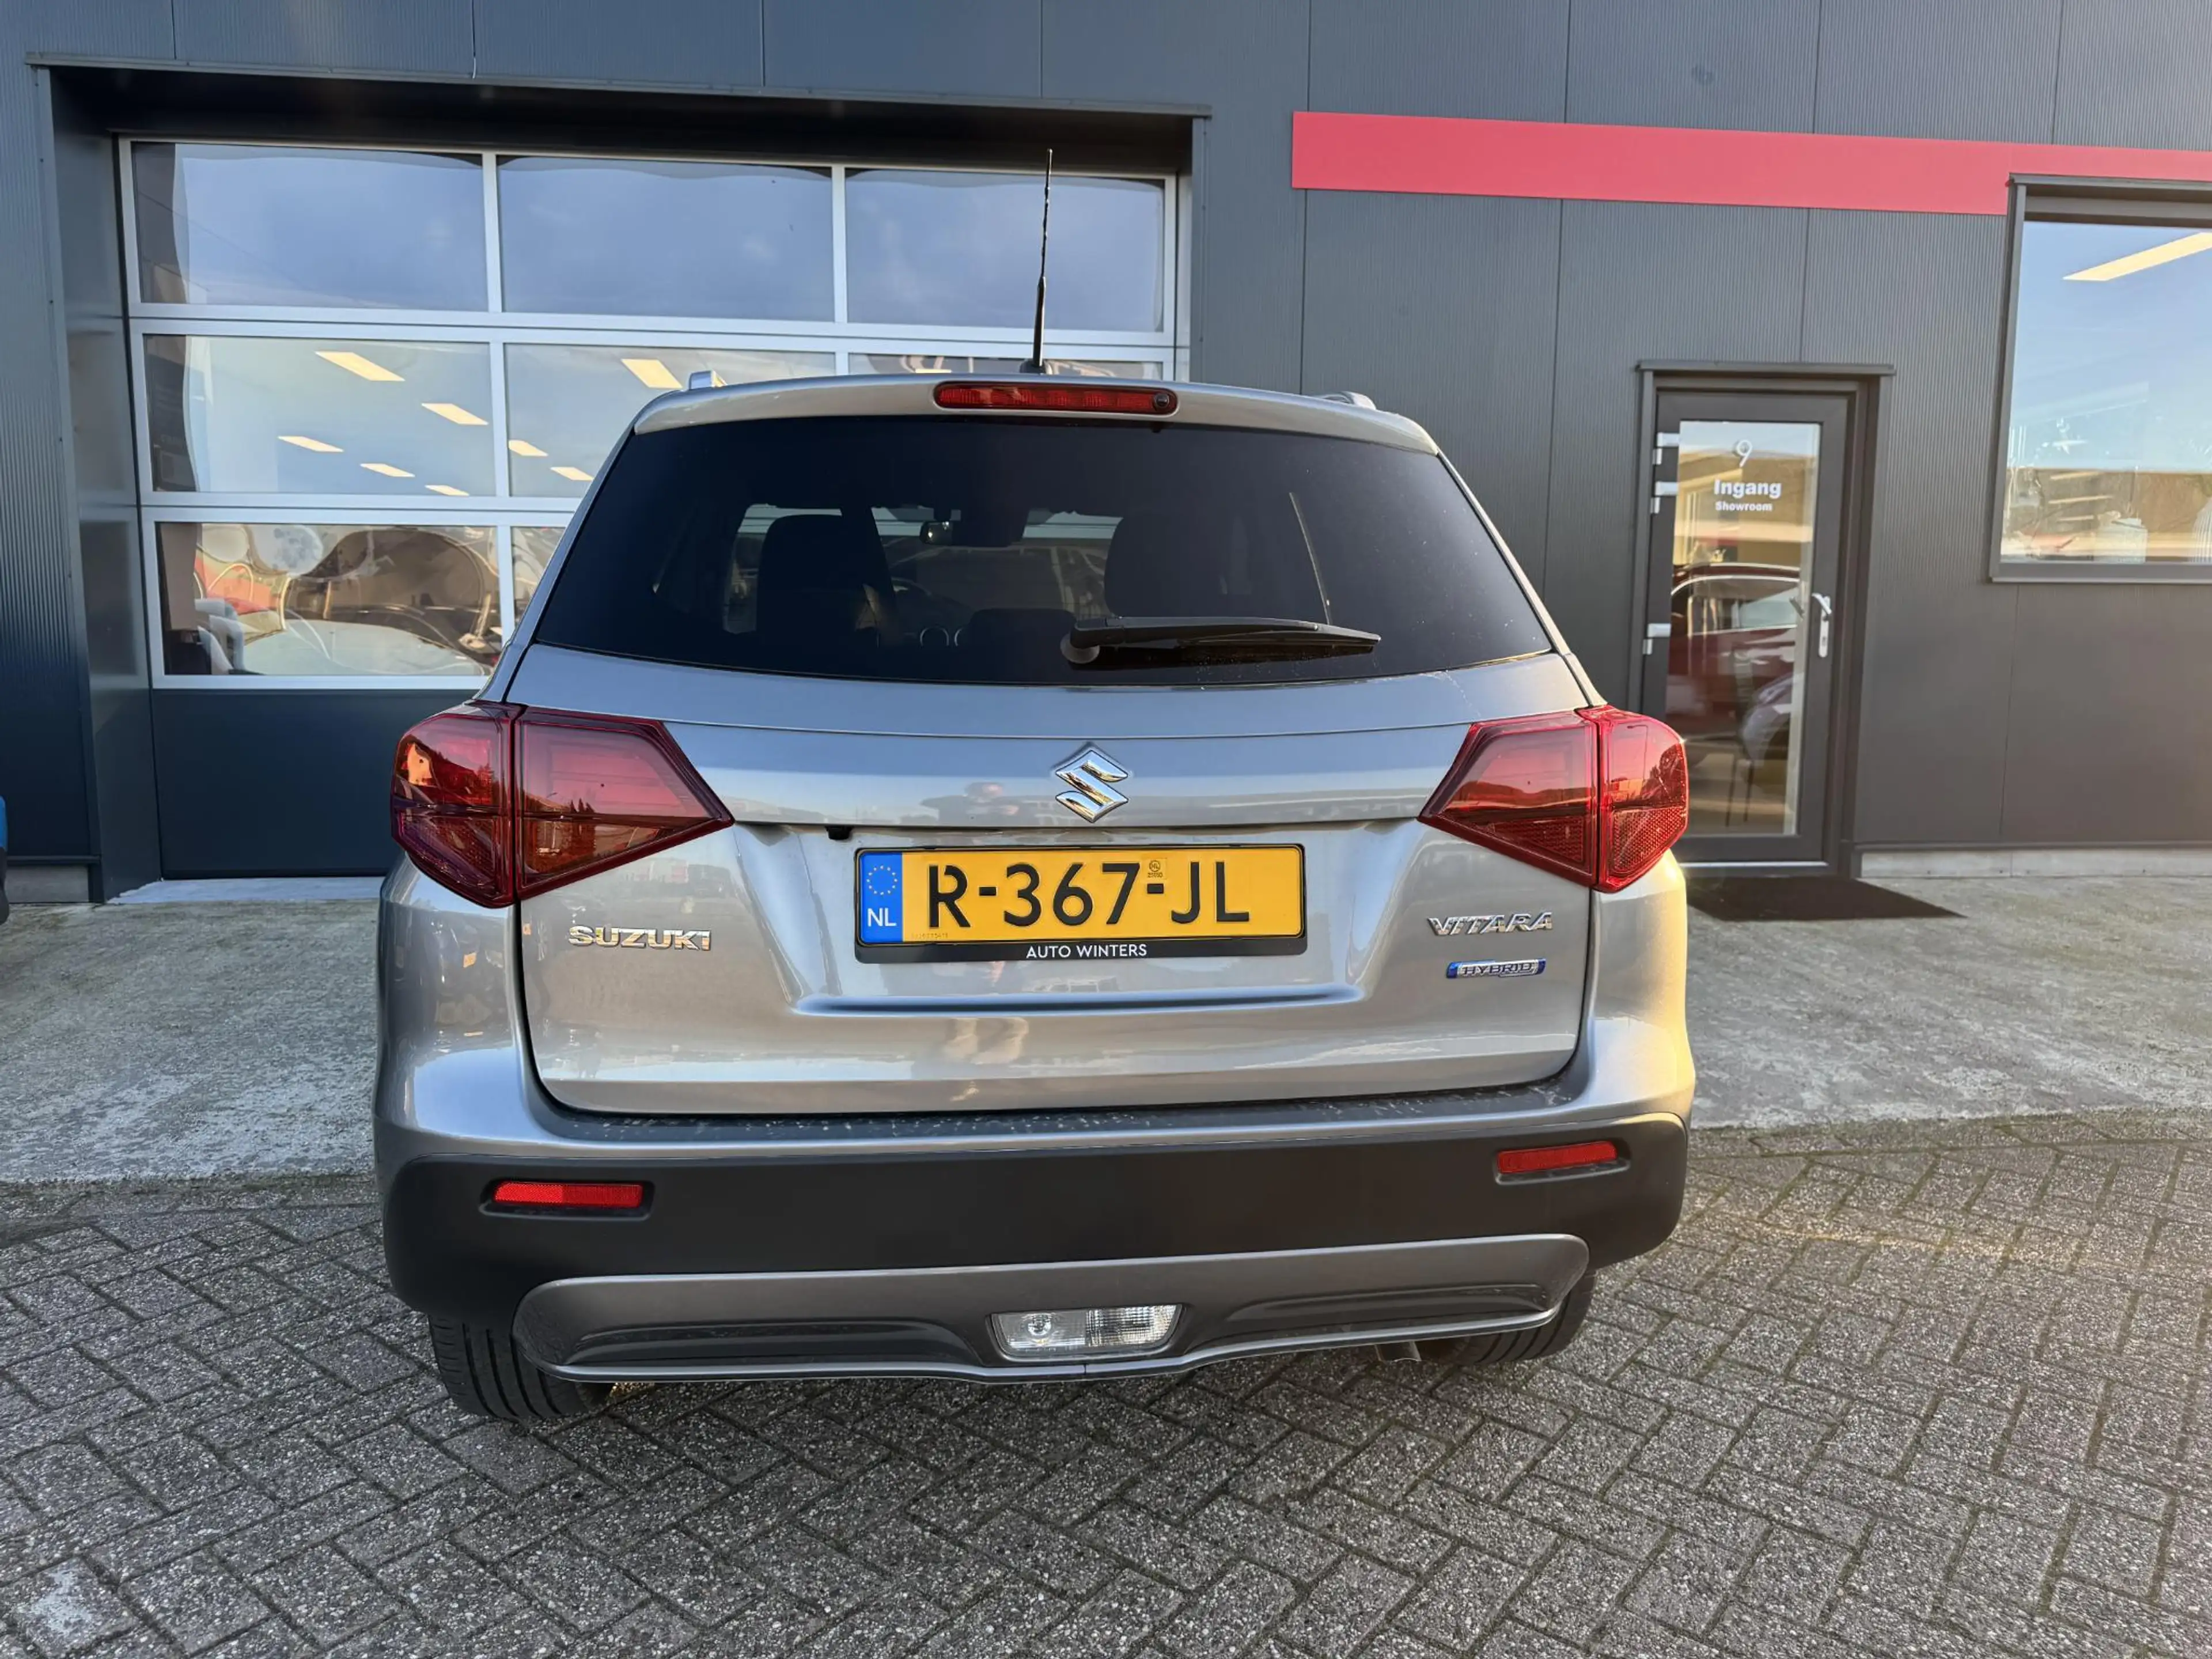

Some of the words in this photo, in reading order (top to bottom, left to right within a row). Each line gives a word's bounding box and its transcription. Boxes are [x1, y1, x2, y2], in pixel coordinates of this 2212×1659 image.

[1735, 439, 1753, 468] 9
[1713, 479, 1782, 498] Ingang
[1715, 501, 1773, 512] Showroom
[928, 860, 1250, 929] R-367-JL
[867, 908, 896, 927] NL
[1427, 911, 1554, 936] VITARA
[568, 925, 711, 952] SUZUKI
[1025, 946, 1071, 959] AUTO
[1076, 944, 1147, 958] WINTERS
[1462, 963, 1533, 976] HYBRID
